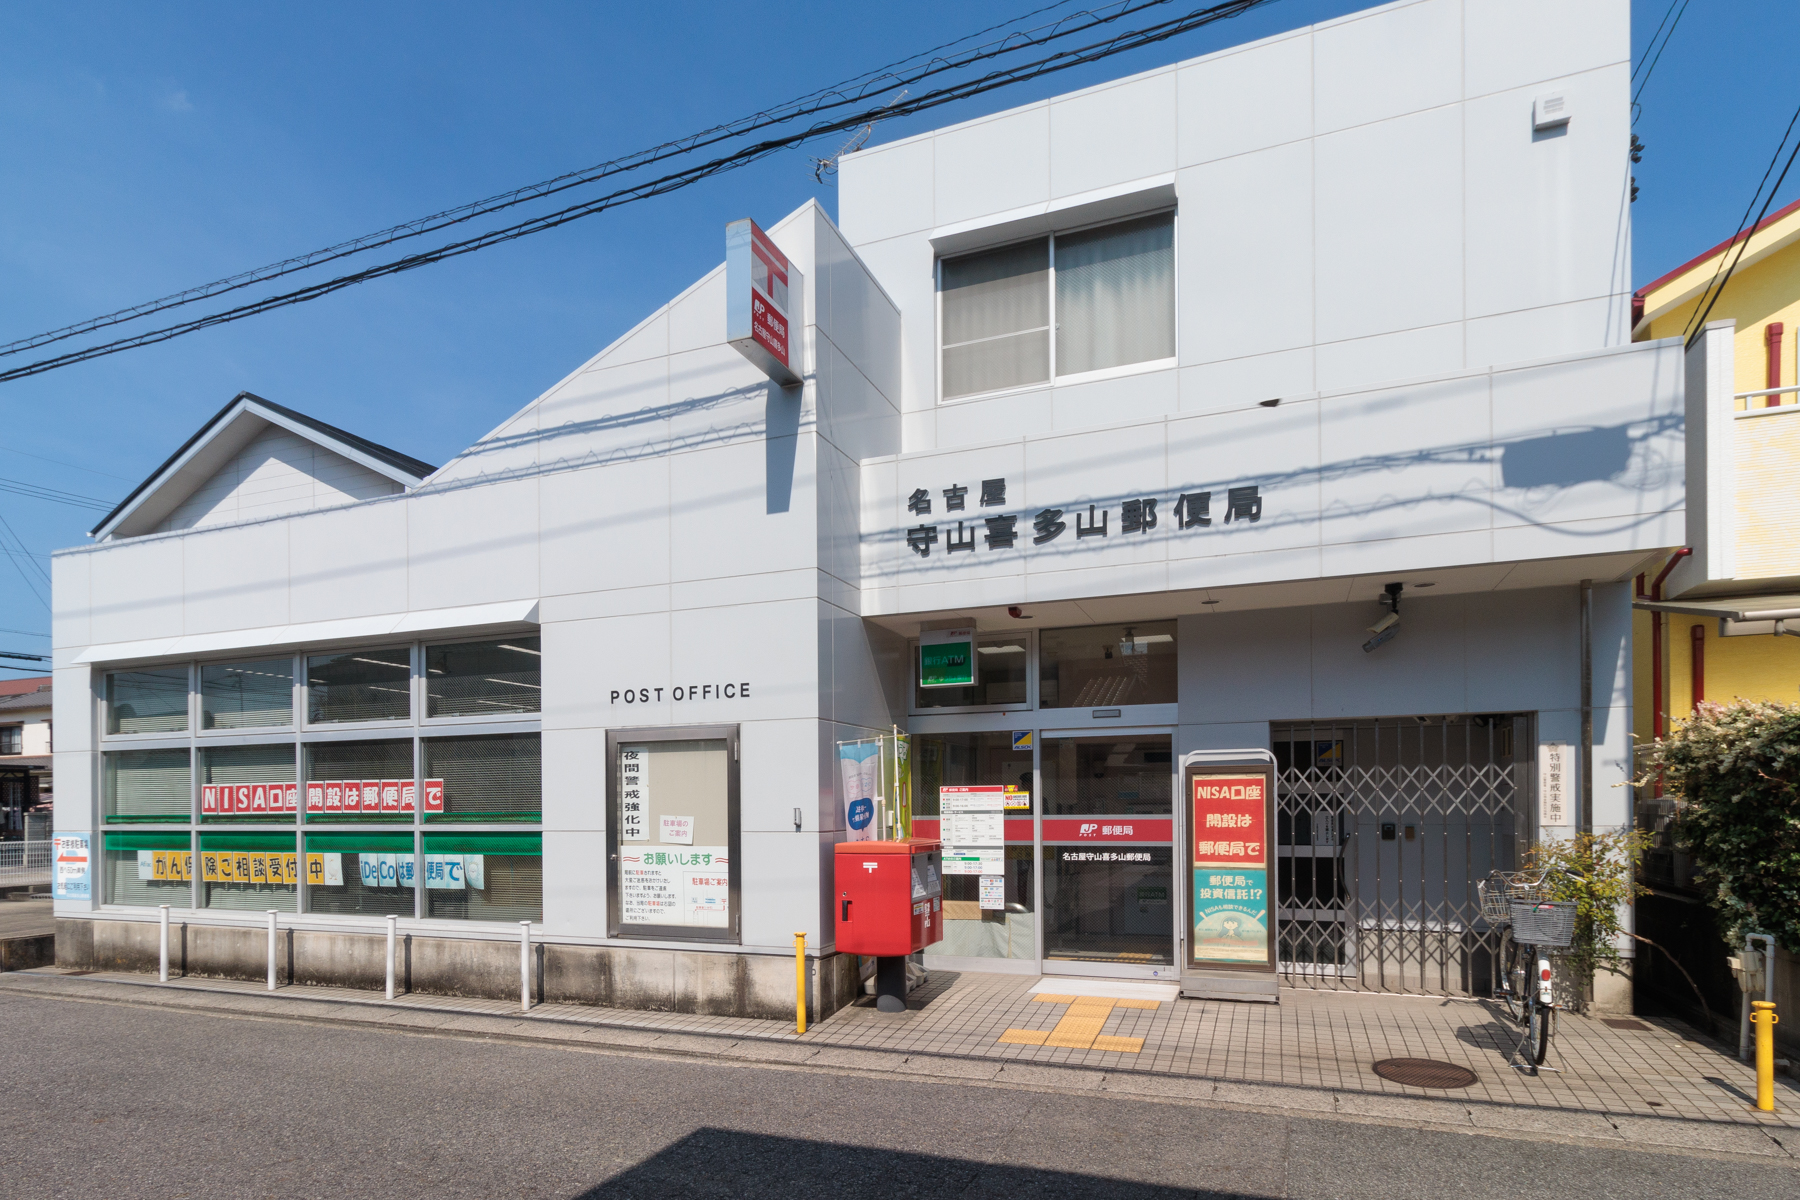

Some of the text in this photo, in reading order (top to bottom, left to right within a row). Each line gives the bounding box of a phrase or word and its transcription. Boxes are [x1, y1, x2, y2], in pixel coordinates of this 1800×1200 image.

[767, 312, 785, 338] 郵便局
[907, 477, 1007, 515] 名古屋
[907, 485, 1263, 557] 守山喜多山郵便局
[610, 682, 750, 704] POST OFFICE
[623, 750, 641, 837] 夜間警戒強化中
[1197, 784, 1262, 800] NISA口座
[1549, 753, 1562, 822] 特別警戒実施中
[1206, 813, 1252, 828] 開設は
[1102, 825, 1133, 835] 郵便局
[1198, 840, 1260, 856] 郵便局で
[643, 852, 713, 866] お願いします
[1062, 852, 1151, 861] 名古屋守山喜多山郵便局
[1209, 875, 1253, 887] 郵便局で
